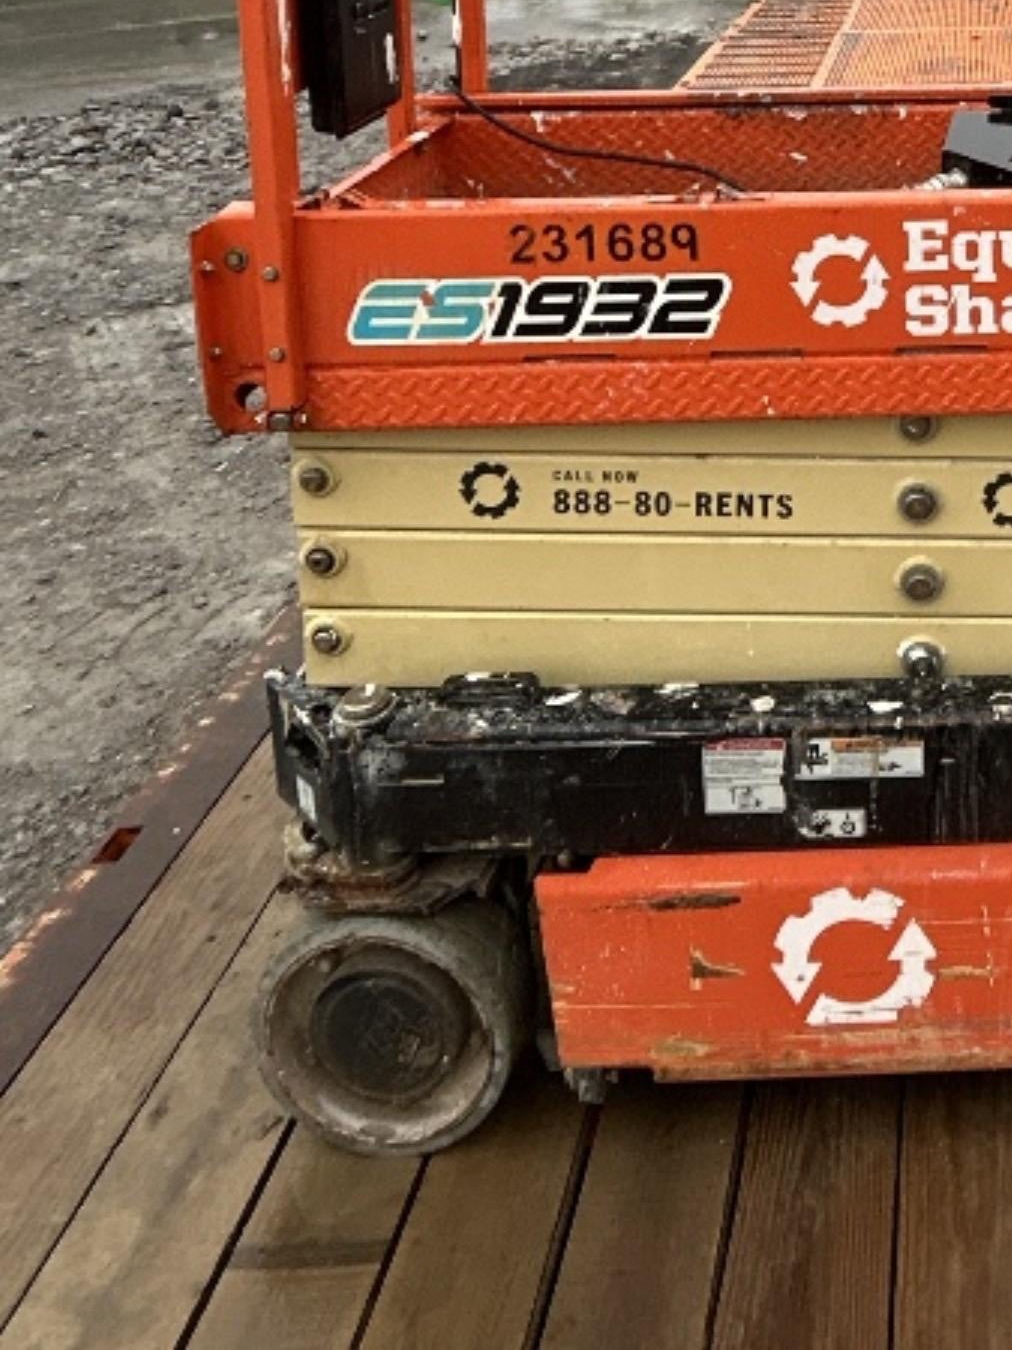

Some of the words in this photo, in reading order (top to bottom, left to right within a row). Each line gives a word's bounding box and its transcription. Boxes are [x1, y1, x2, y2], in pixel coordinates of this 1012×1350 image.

[509, 223, 699, 265] 231689
[347, 273, 731, 344] ES1932
[552, 470, 595, 484] CALL
[601, 470, 639, 484] NOW
[552, 488, 794, 520] 888-80-RENTS
